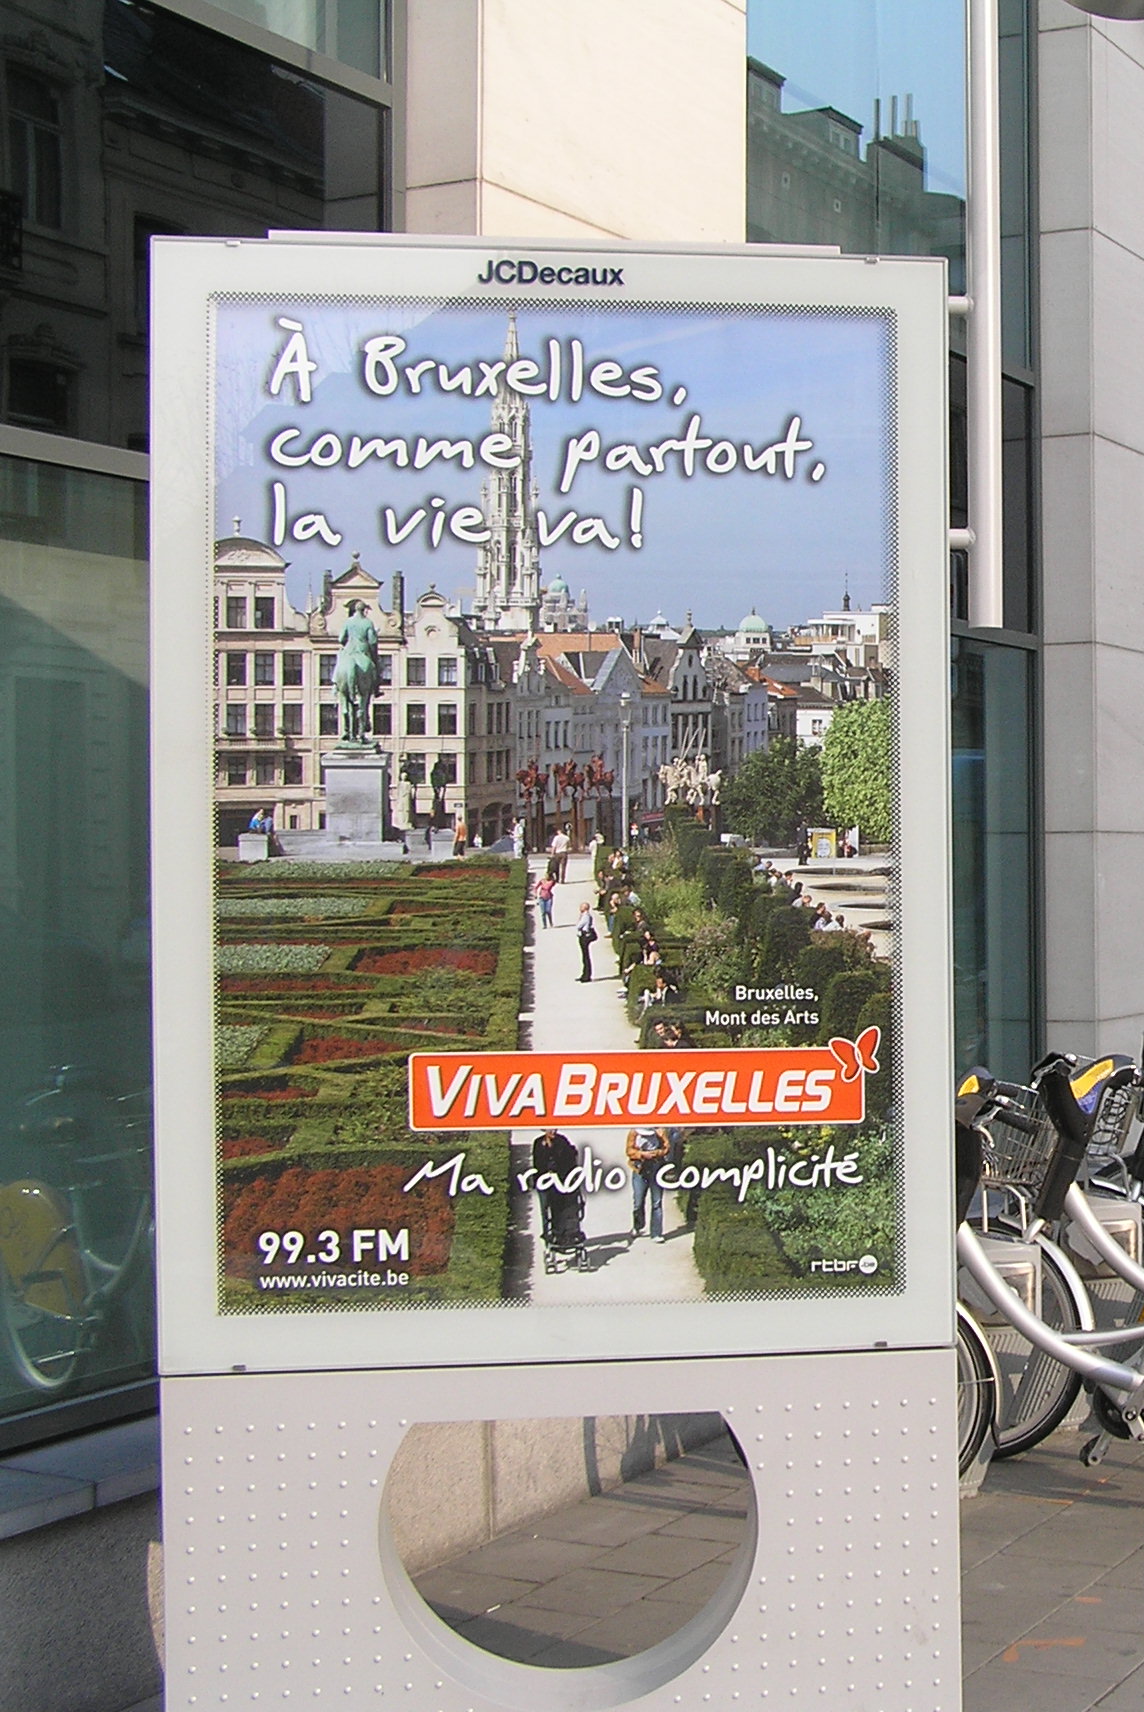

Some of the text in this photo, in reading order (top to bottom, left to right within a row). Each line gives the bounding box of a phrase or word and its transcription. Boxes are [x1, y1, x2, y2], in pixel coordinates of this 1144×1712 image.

[478, 259, 625, 287] JCDecaux
[270, 317, 688, 405] À Bruxelles,
[271, 414, 826, 494] comme partout,
[272, 482, 644, 549] la vie va!
[735, 985, 819, 1002] Bruxelles,
[705, 1009, 819, 1026] Mont des Arts
[403, 1145, 864, 1202] Ma radio complicité
[258, 1228, 410, 1264] 99.3 FM
[259, 1269, 410, 1288] www.vivacite.be
